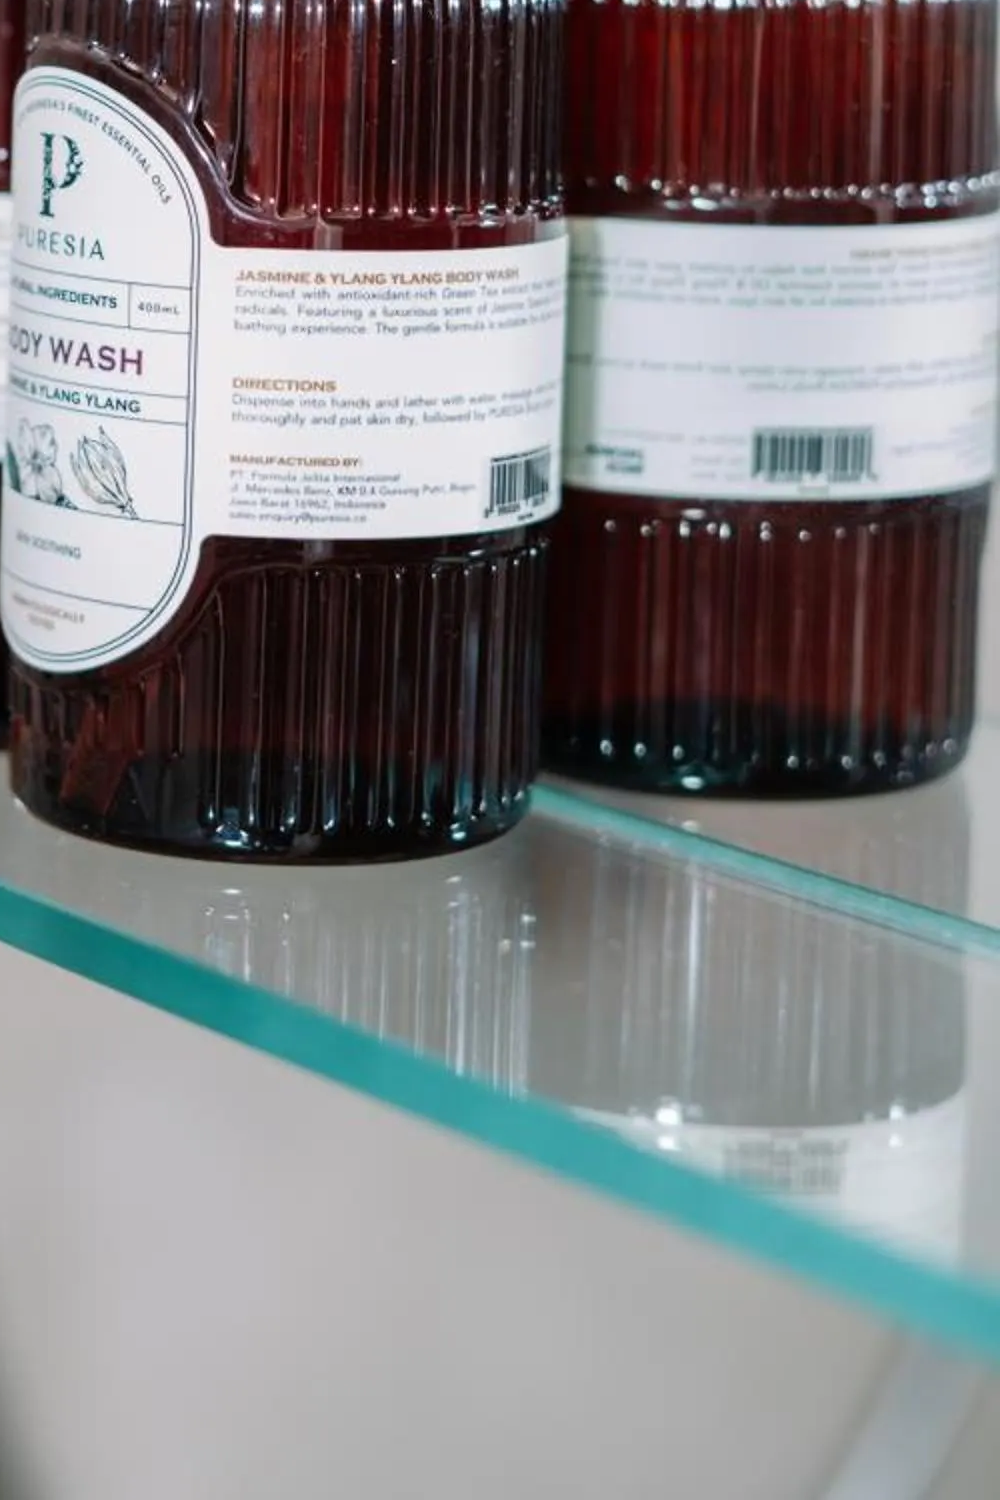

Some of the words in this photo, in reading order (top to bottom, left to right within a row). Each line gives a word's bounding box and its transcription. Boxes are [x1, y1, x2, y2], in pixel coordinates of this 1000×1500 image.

[68, 104, 99, 126] FINEST
[101, 122, 151, 175] ESSENTIAL
[151, 174, 172, 204] OILS
[235, 270, 310, 284] JASMINE
[313, 272, 326, 285] &
[329, 272, 387, 285] YLANG
[391, 272, 442, 285] YLANG
[445, 271, 482, 283] BODY
[484, 268, 519, 281] WASH
[37, 285, 117, 309] INGREDIENTS
[235, 285, 295, 299] Enriched
[302, 287, 331, 300] with
[442, 286, 476, 299] Green
[297, 304, 363, 321] Featuring
[368, 308, 377, 318] a
[381, 304, 437, 318] luxurious
[234, 319, 286, 337] bathing
[375, 321, 399, 335] The
[402, 323, 441, 337] gentle
[9, 324, 43, 357] ODY
[49, 336, 143, 375] WASH
[232, 377, 338, 393] DIRECTIONS
[38, 384, 81, 405] YLANG
[84, 392, 141, 413] YLANG
[232, 392, 295, 408] Dispense
[300, 396, 326, 409] into
[331, 397, 371, 410] hands
[375, 396, 399, 409] and
[232, 410, 306, 427] thoroughly
[311, 413, 338, 426] and
[339, 414, 362, 428] pat
[366, 413, 391, 426] skin
[423, 410, 471, 423] followed
[229, 454, 341, 468] MANUFACTURED
[250, 470, 298, 482] Formula
[337, 485, 357, 496] KM
